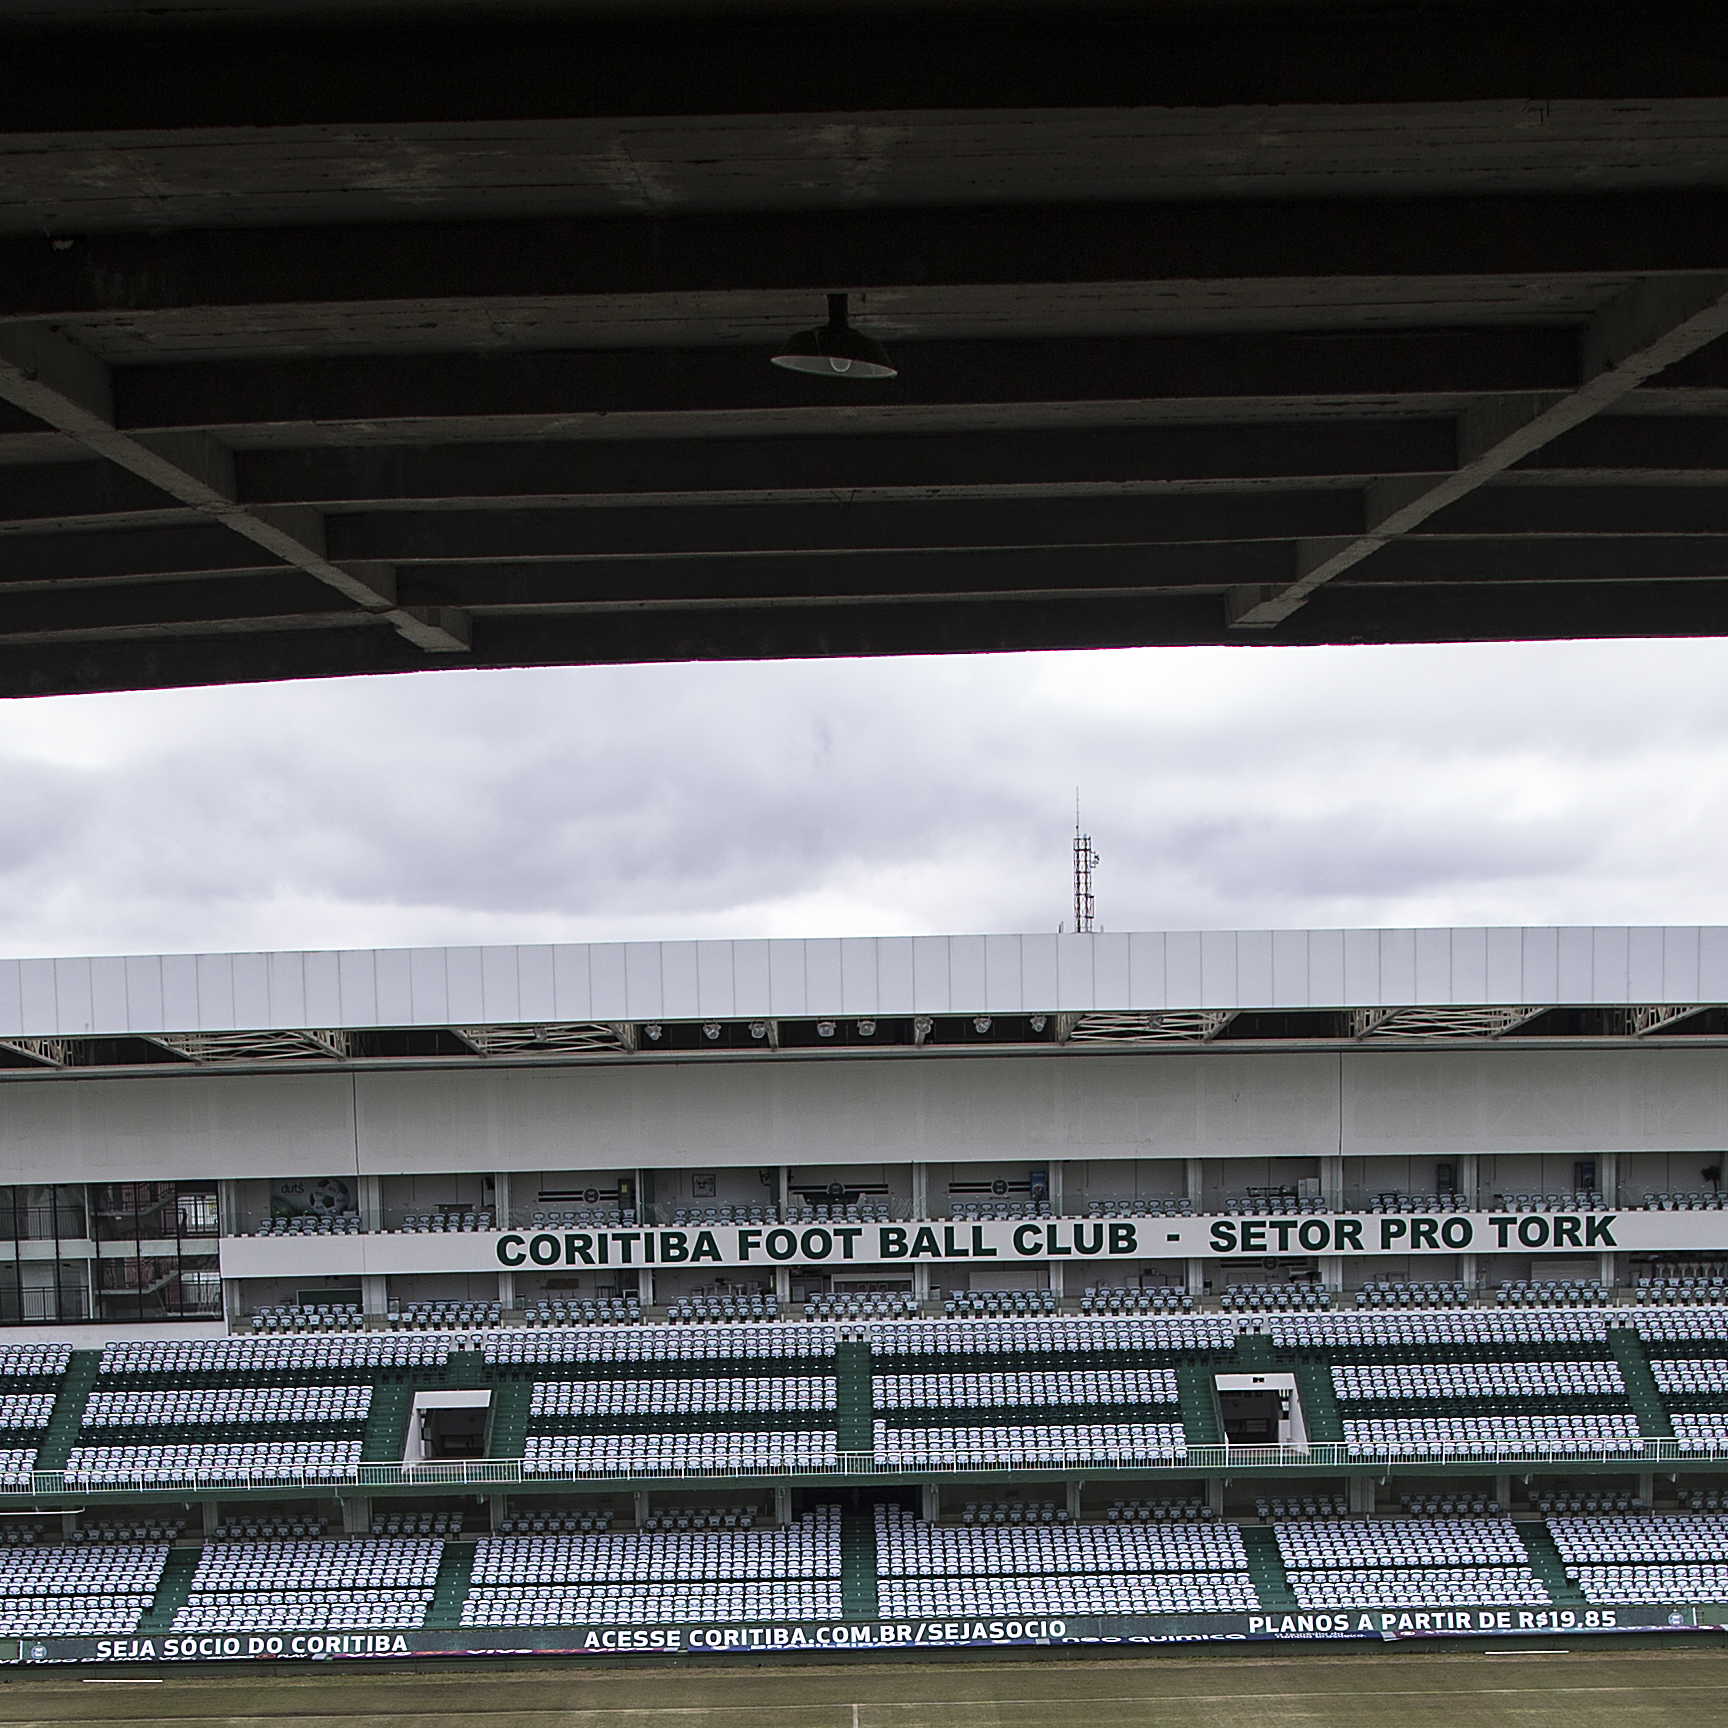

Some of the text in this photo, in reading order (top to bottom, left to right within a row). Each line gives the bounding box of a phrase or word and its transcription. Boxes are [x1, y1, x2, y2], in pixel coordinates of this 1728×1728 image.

[495, 1229, 723, 1267] CORITIBA
[737, 1227, 863, 1262] FOOT
[879, 1225, 998, 1259] BALL
[1012, 1222, 1138, 1257] CLUB
[1209, 1218, 1365, 1254] SETOR
[1380, 1216, 1474, 1250] PRO
[1488, 1214, 1618, 1249] TORK
[584, 1619, 1067, 1648] ACESSE CORITIBA.COM.BR/SEJASOCIO
[1248, 1614, 1350, 1634] PLANOS
[1357, 1613, 1374, 1632] A
[1381, 1612, 1472, 1632] PARTIR
[1479, 1611, 1512, 1629] DE
[1519, 1610, 1617, 1630] R$19,85
[96, 1635, 408, 1659] SEJA SÓCIO DO CORITIBA
